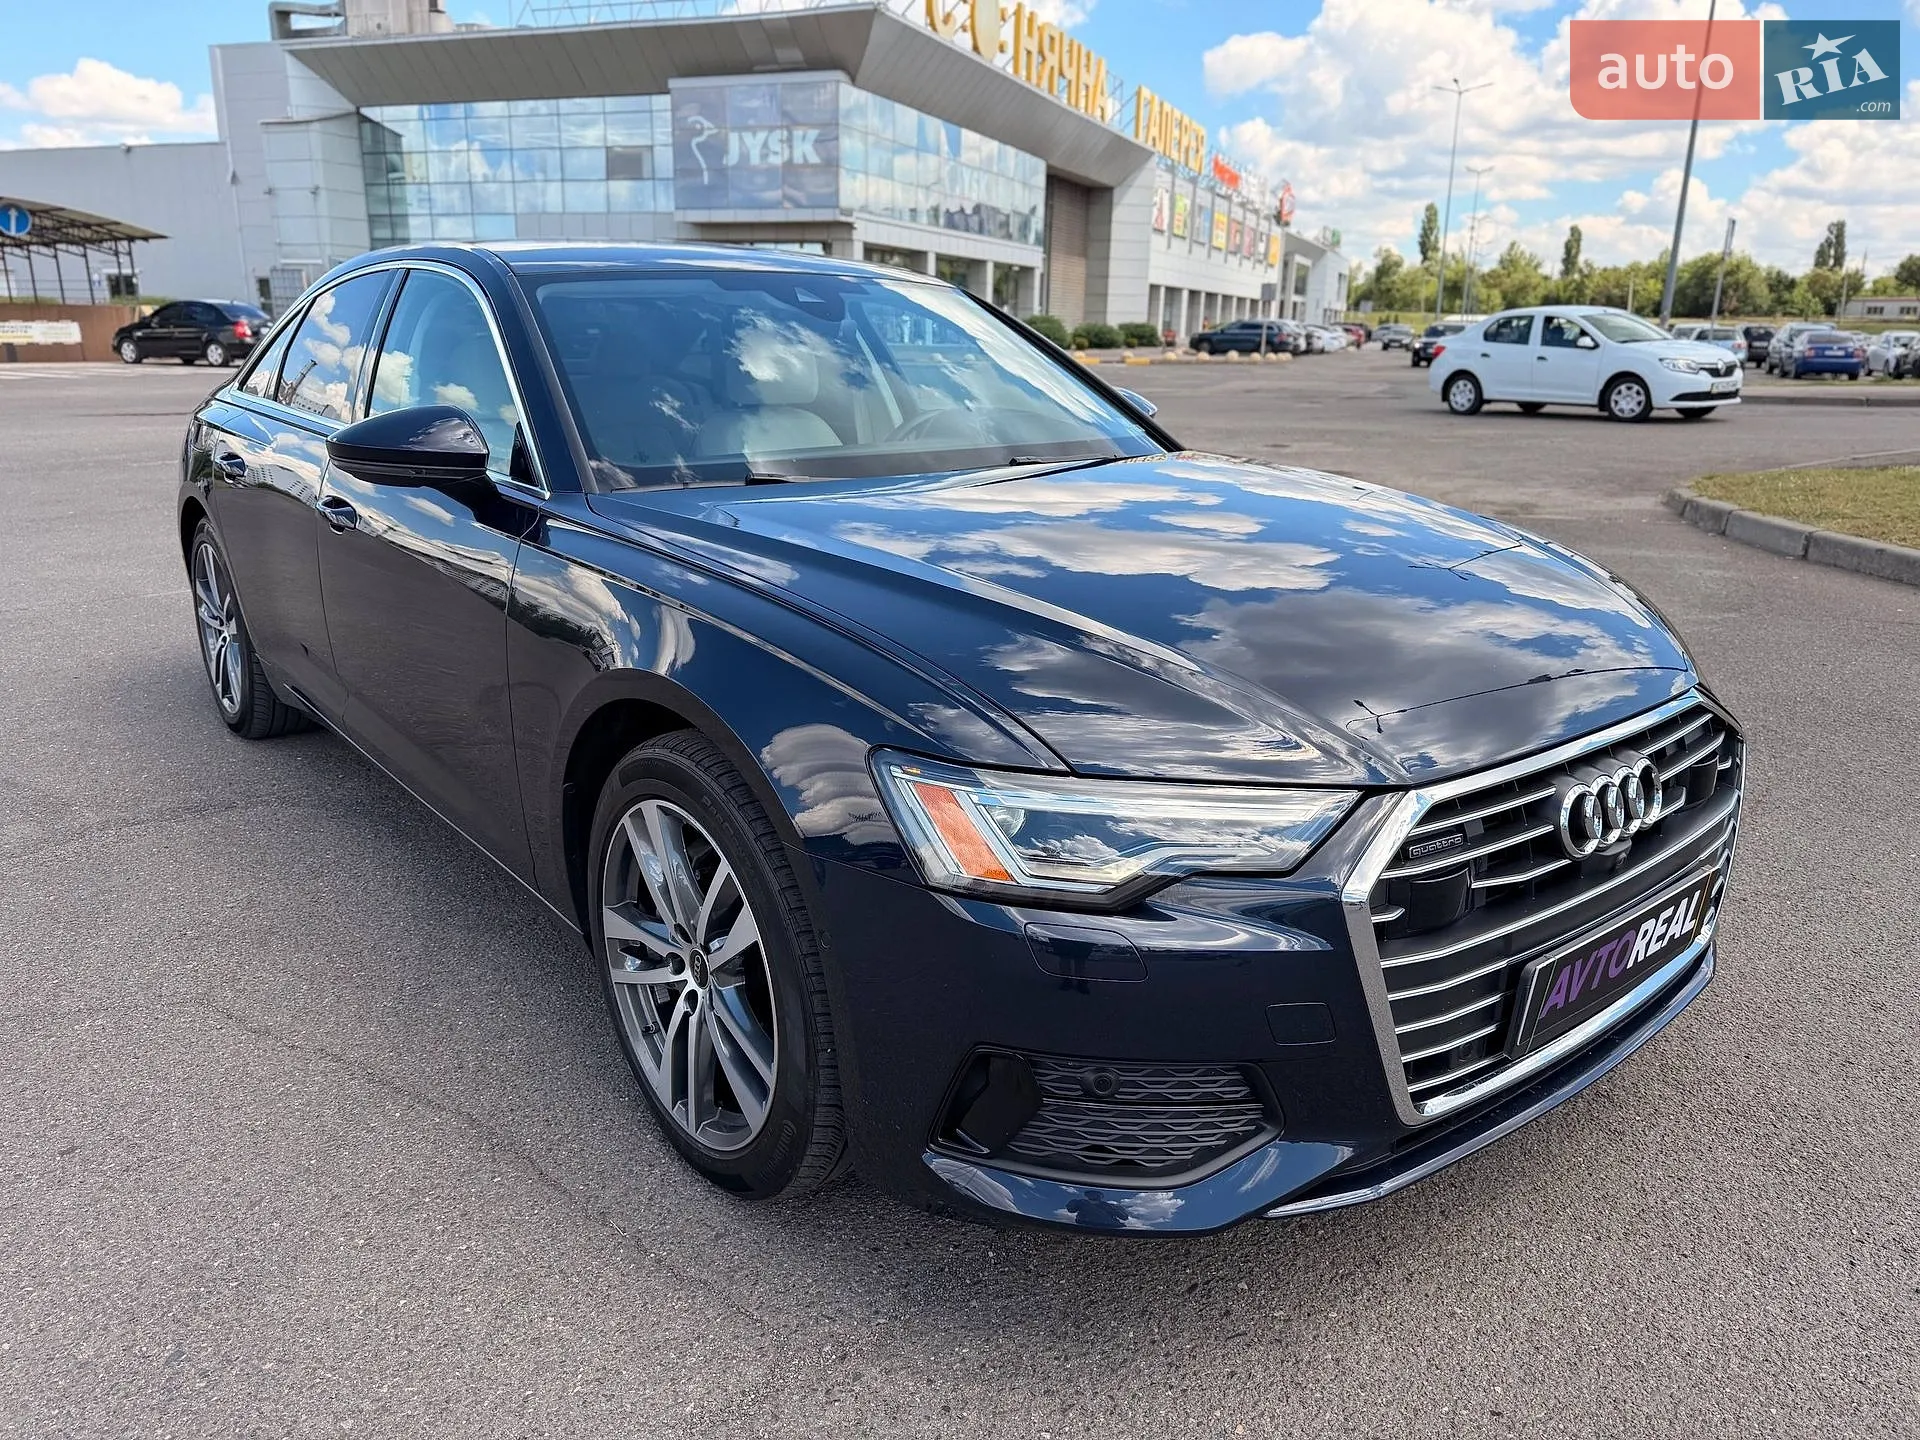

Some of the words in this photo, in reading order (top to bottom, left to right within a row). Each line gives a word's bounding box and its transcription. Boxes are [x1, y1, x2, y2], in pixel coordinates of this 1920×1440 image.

[723, 128, 821, 166] JYSK
[1135, 84, 1206, 175] ГАЛЕРЕЯ
[1412, 836, 1463, 857] quattro
[1539, 889, 1701, 1019] AVTOREAL
